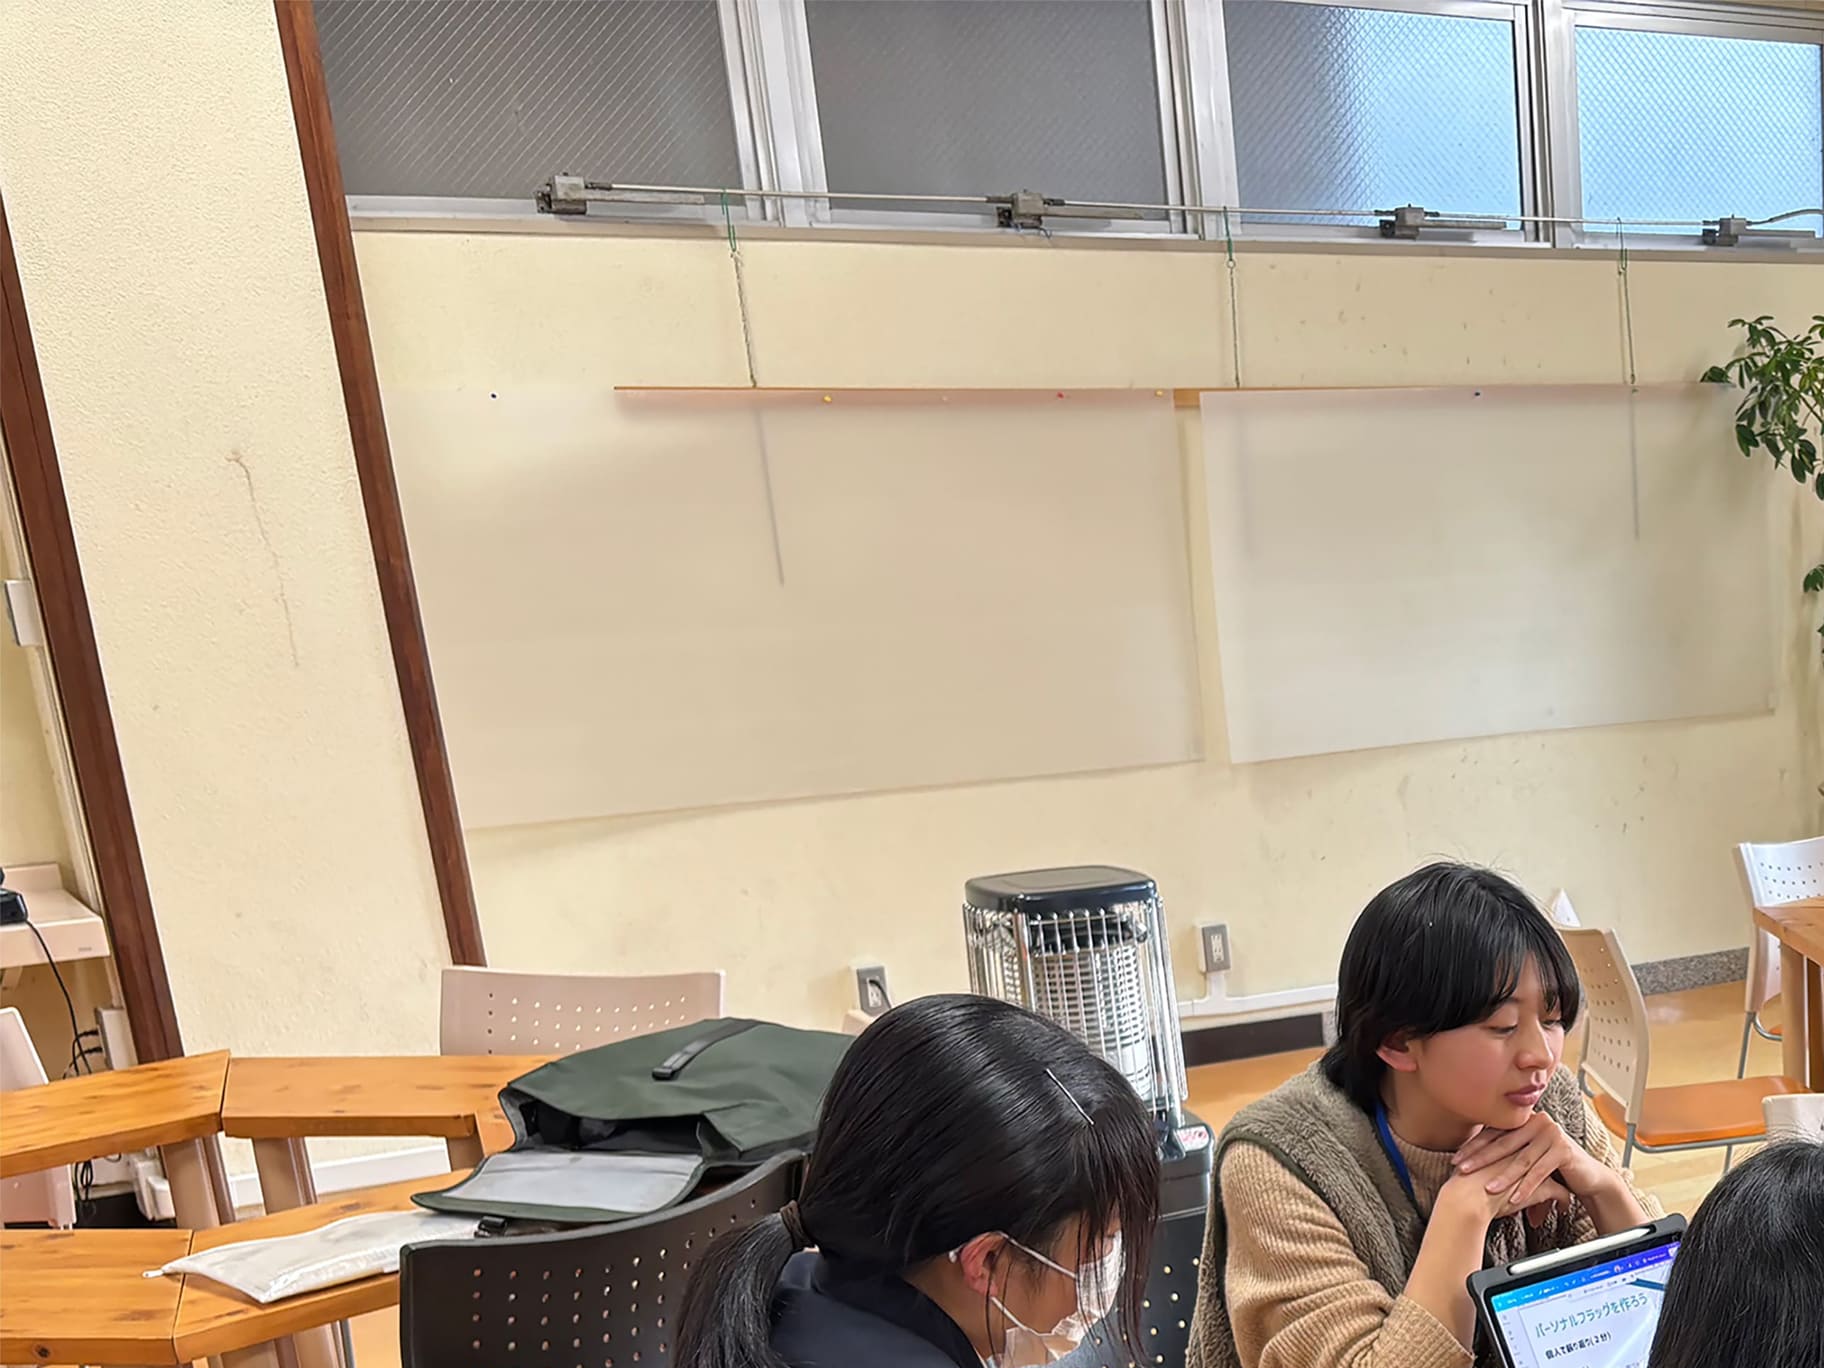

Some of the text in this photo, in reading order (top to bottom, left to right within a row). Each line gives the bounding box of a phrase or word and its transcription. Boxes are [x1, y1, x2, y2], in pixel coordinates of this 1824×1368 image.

[1535, 1292, 1649, 1338] パーソナルフラッグを作ろう
